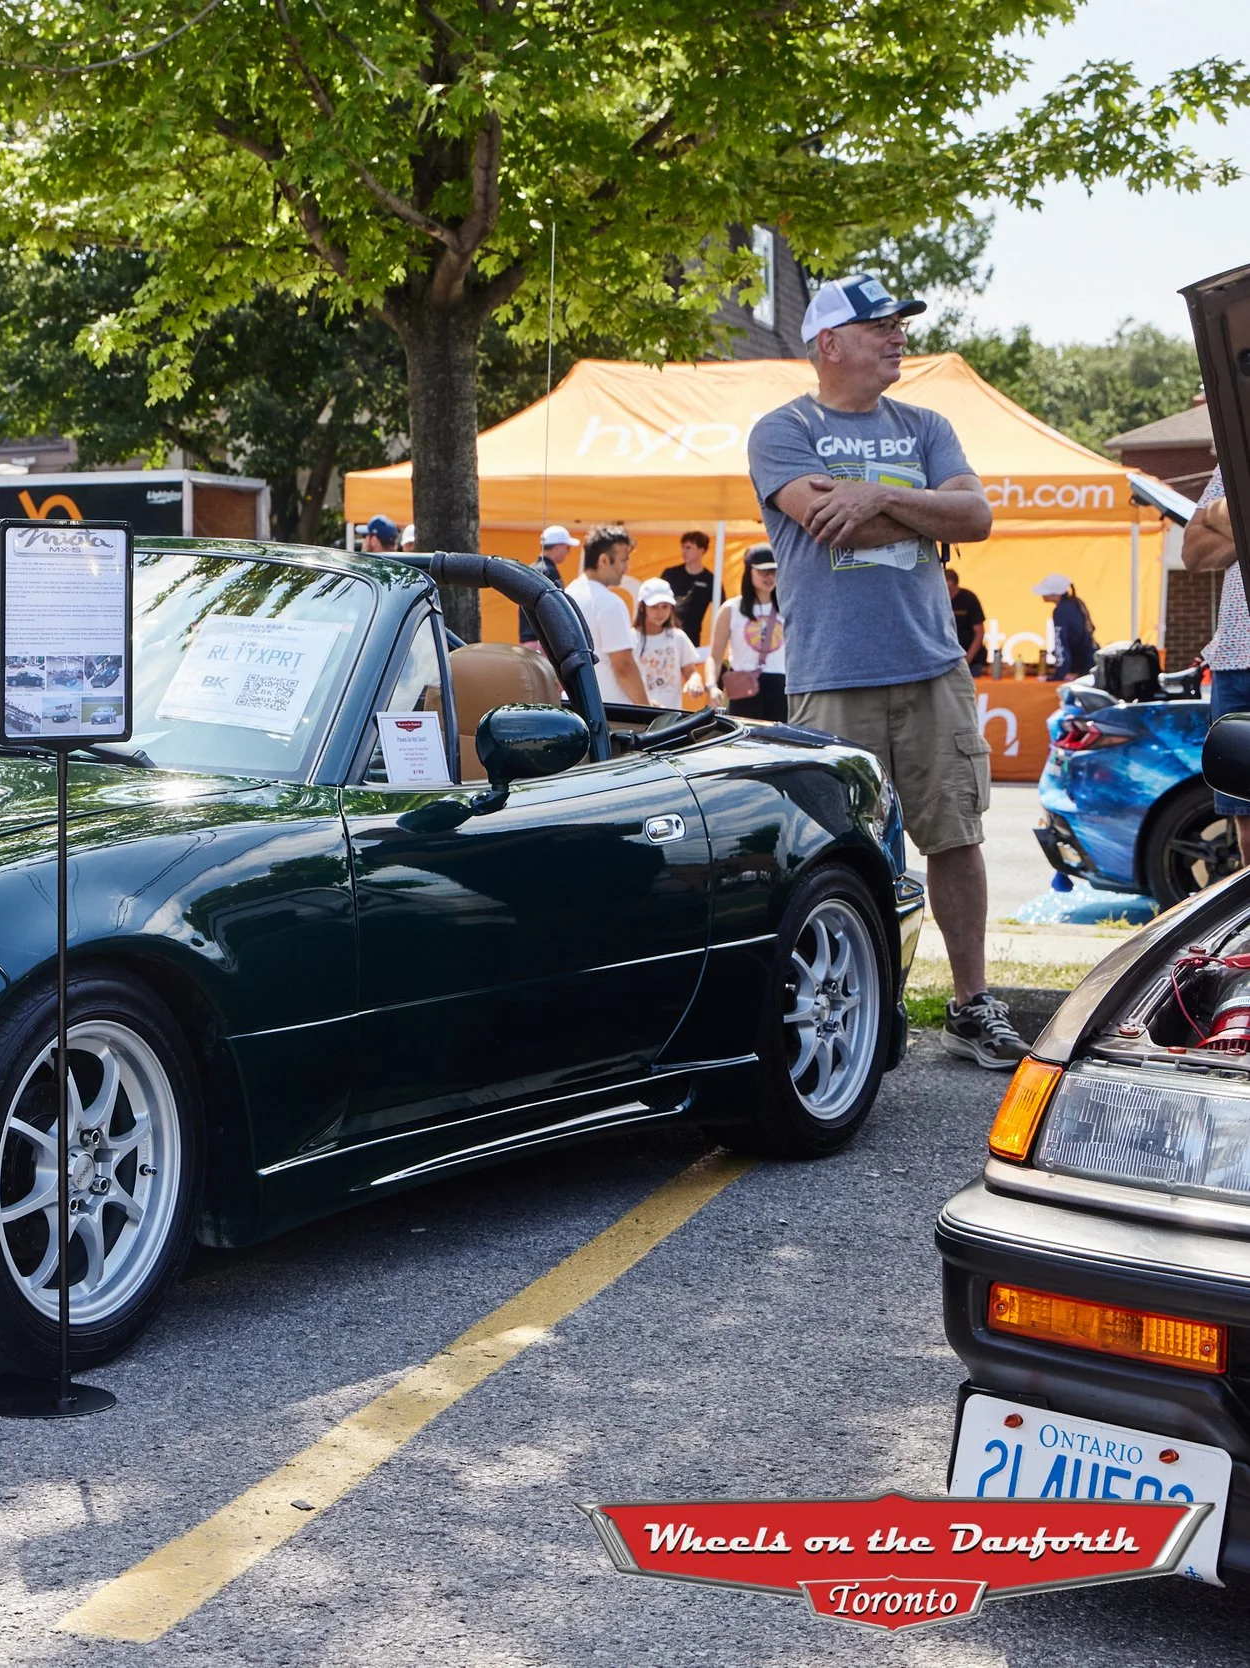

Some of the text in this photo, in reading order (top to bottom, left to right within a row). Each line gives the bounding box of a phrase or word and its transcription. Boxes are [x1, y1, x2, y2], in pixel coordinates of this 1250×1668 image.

[816, 435, 876, 459] GAME
[983, 477, 1114, 508] ch.com
[207, 644, 306, 668] RLTYXPRT
[1039, 1424, 1143, 1465] ONTARIO
